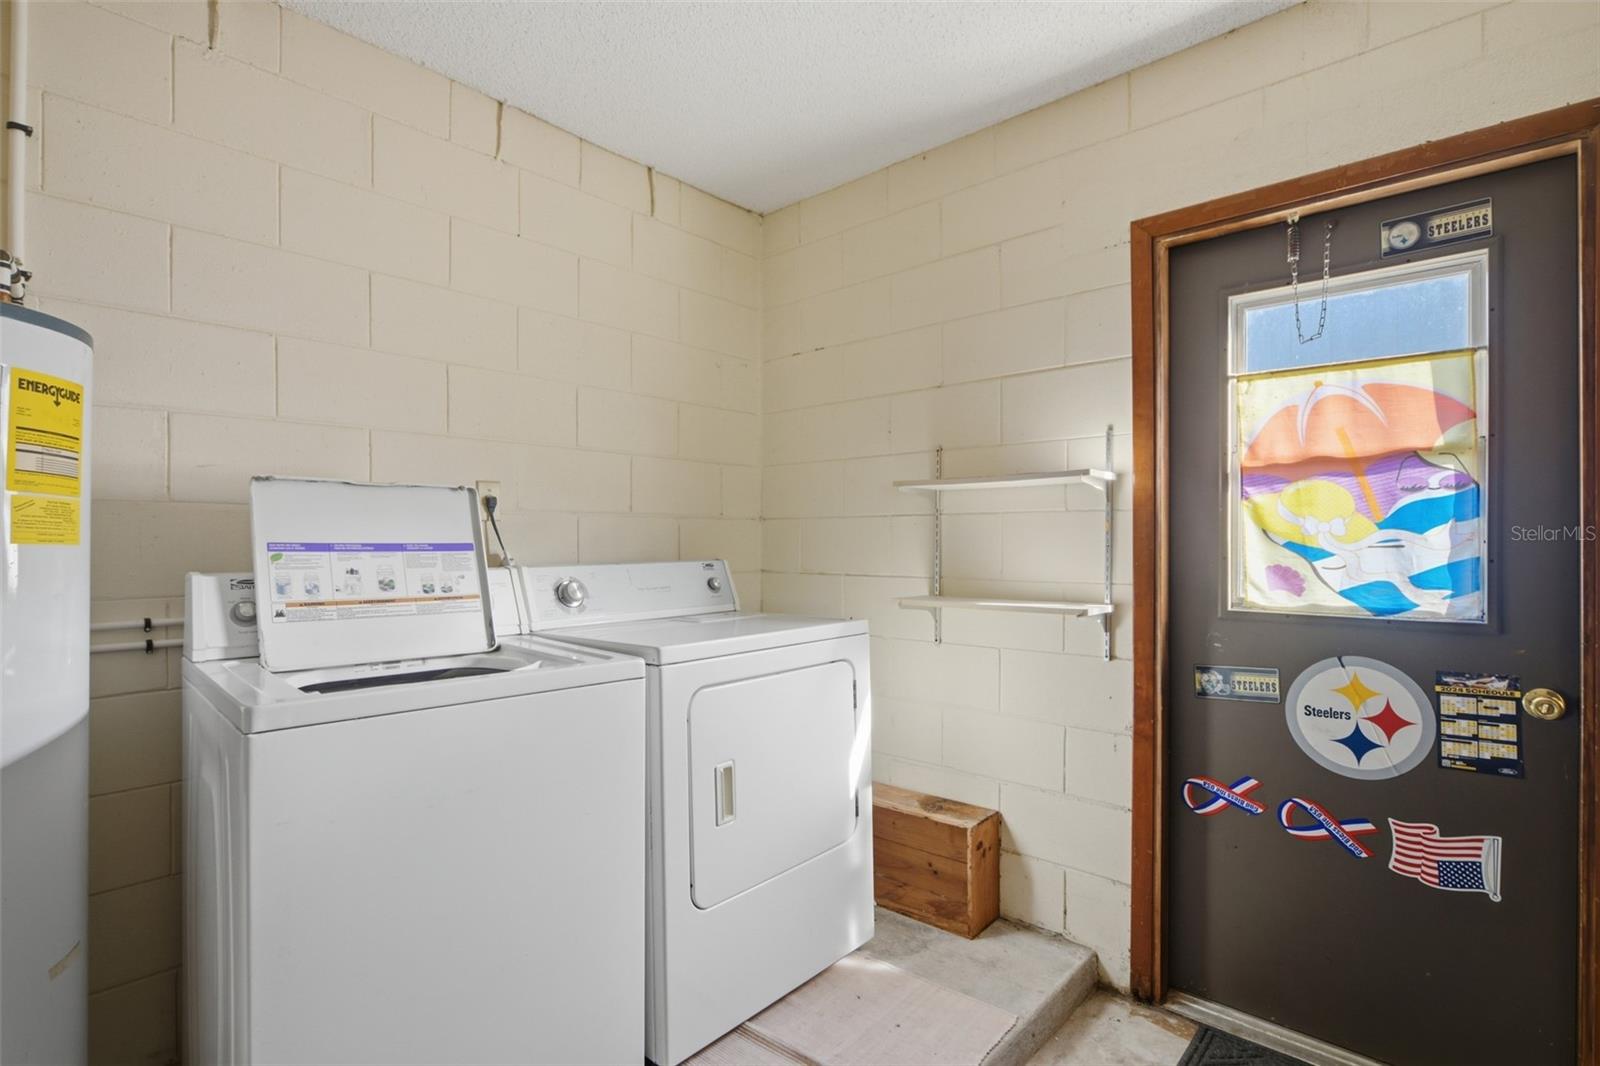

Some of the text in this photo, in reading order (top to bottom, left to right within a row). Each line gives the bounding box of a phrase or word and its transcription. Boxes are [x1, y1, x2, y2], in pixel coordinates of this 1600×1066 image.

[1428, 213, 1489, 237] STEELERS
[18, 377, 81, 405] ENERGYGUIDE
[1231, 680, 1278, 693] STEELERS
[1465, 688, 1516, 697] SCHEDULE
[1304, 704, 1352, 721] Steelers
[1202, 780, 1259, 813] God Bless the USA
[1309, 805, 1364, 857] God Bless the USA
